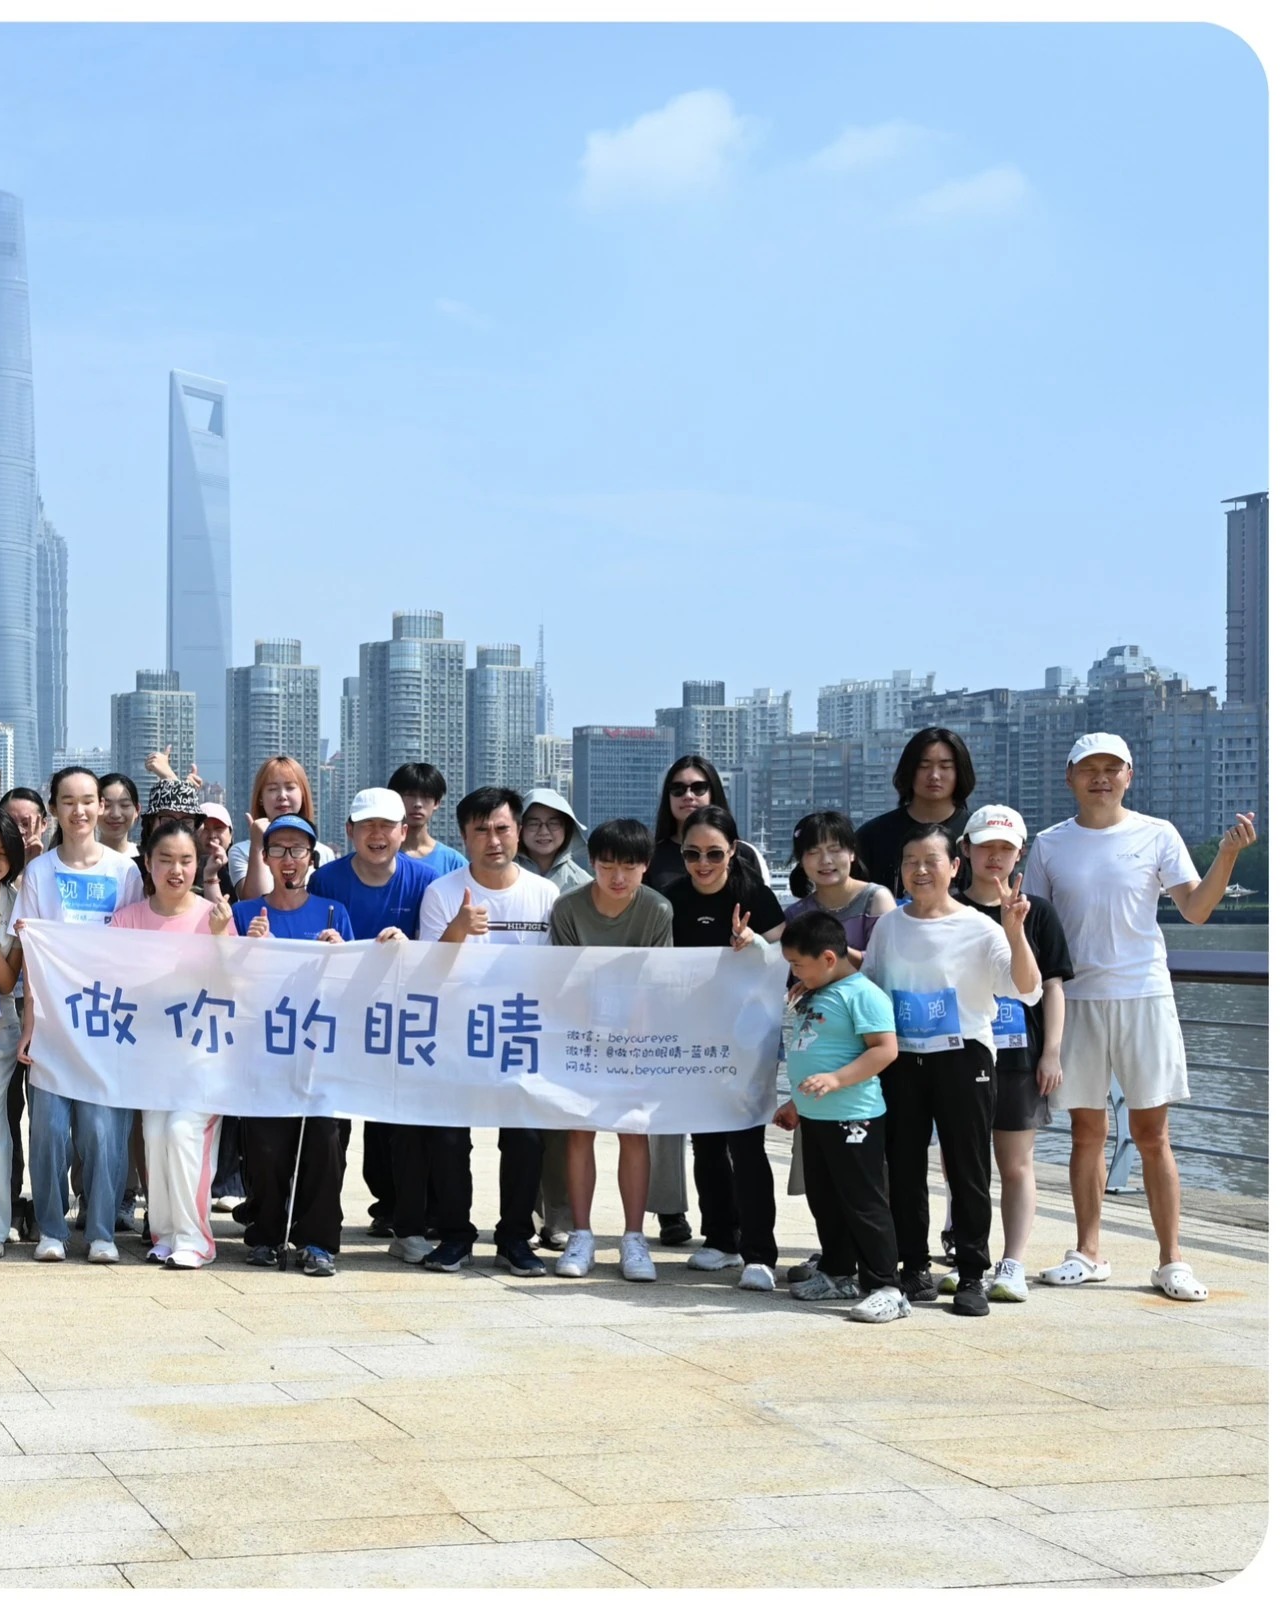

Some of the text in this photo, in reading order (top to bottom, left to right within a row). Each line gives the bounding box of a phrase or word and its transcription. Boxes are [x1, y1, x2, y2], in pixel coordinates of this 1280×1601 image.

[59, 880, 106, 901] 视障
[898, 998, 947, 1022] 陪跑
[65, 980, 542, 1075] 做你的眼睛
[608, 1031, 679, 1045] beyoureyes
[606, 1063, 738, 1077] www.beyoureyes.org
